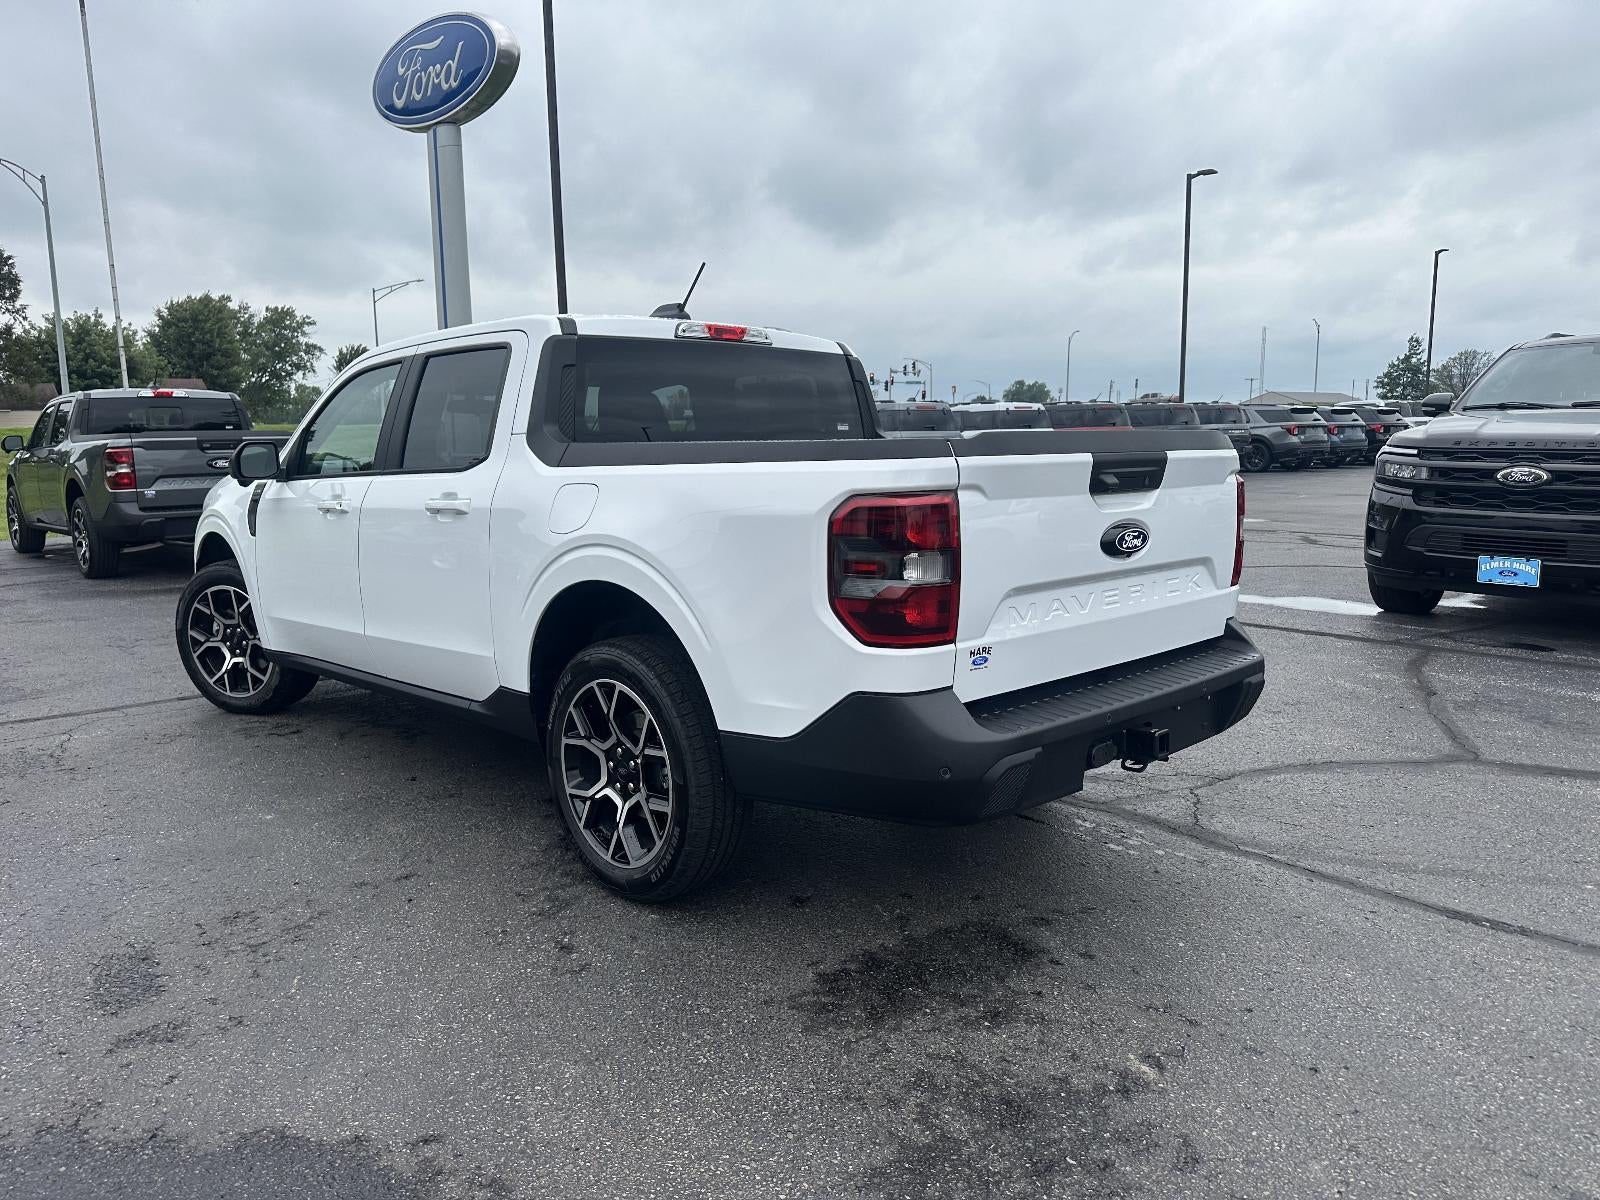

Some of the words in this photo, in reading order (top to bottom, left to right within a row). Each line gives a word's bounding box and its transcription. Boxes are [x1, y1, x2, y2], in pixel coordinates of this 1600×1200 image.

[392, 35, 464, 110] Ford
[1507, 470, 1535, 482] Ford
[1122, 531, 1143, 548] Ford
[1481, 560, 1511, 571] ELMER
[1512, 561, 1537, 575] HARE
[1009, 573, 1203, 627] MAVERICK
[969, 646, 993, 658] HARE
